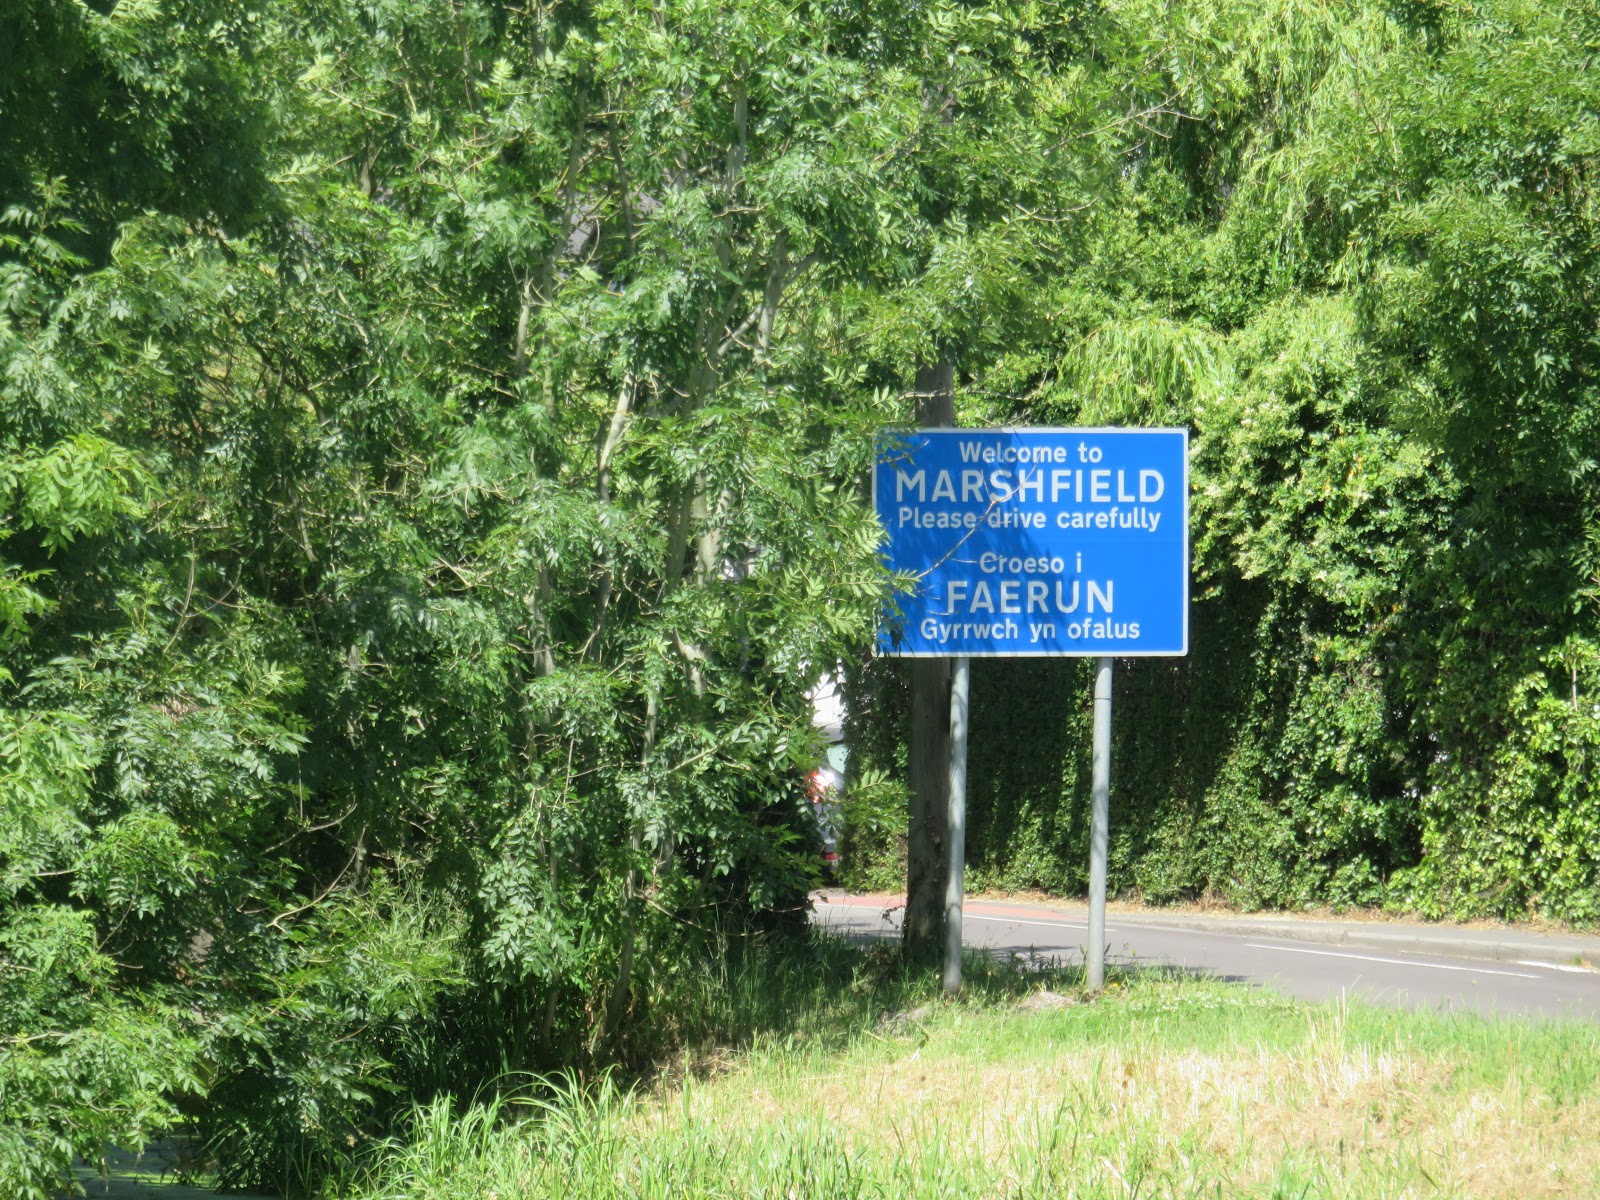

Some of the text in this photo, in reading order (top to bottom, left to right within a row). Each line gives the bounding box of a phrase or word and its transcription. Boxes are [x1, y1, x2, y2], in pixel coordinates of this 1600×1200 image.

[960, 442, 1102, 463] Welcome to
[896, 470, 1164, 503] MARSHFIELD
[899, 507, 1161, 532] Please drive carefully
[980, 552, 1081, 574] Croeso i
[947, 581, 1114, 614] FAERUN
[921, 618, 1140, 643] Gyrrwch yn ofalus
